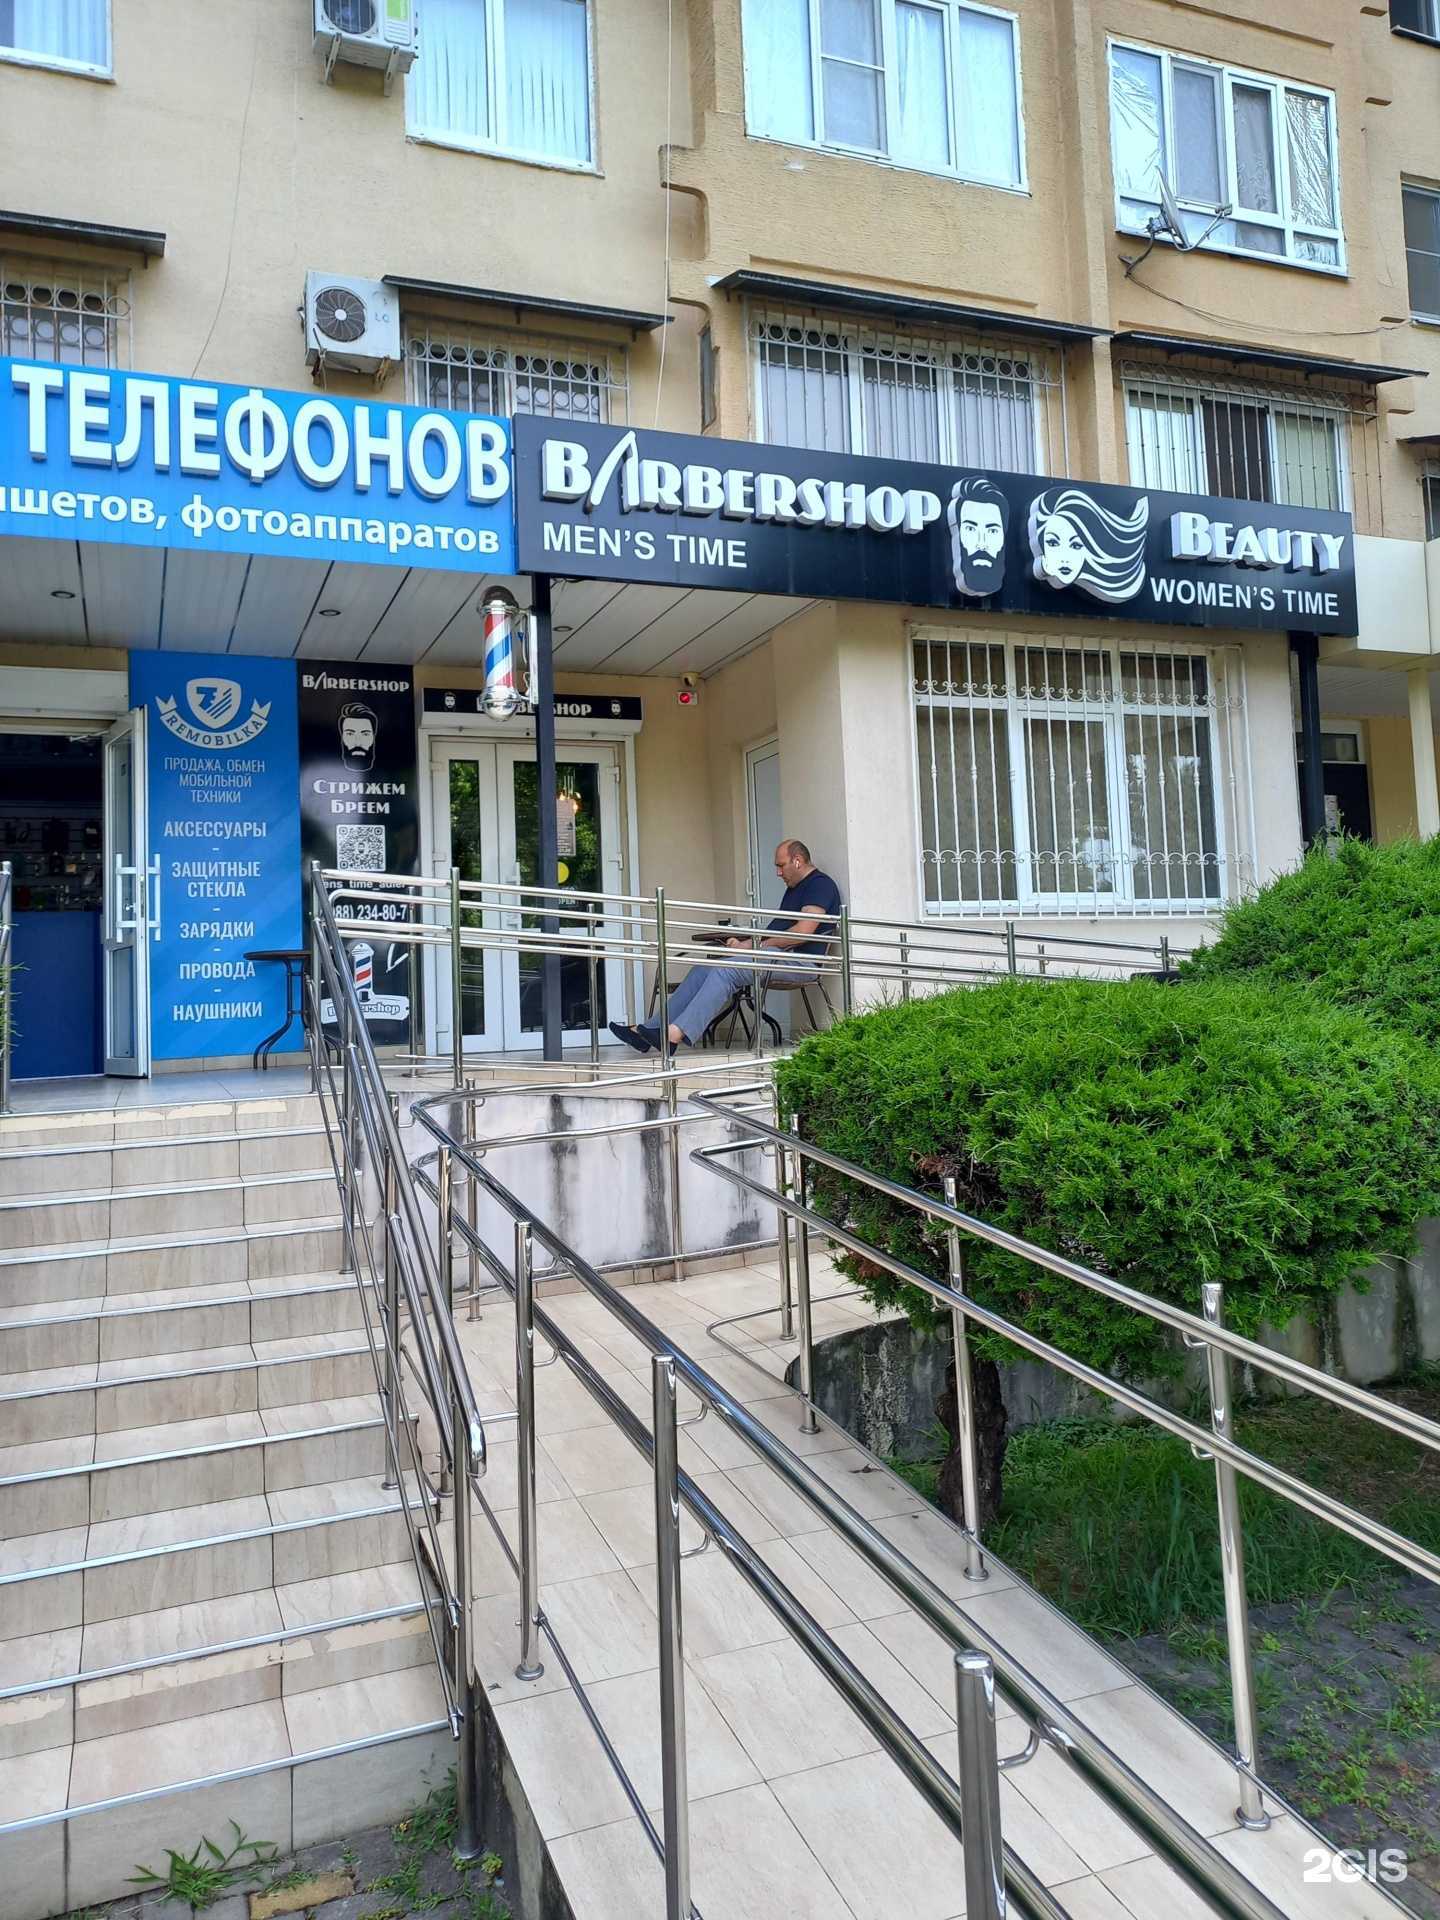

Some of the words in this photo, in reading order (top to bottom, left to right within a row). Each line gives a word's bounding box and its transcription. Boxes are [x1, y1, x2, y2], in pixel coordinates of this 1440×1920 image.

[11, 364, 510, 505] ТЕЛЕФОНОВ
[541, 430, 942, 534] BARBERSHOP
[0, 486, 169, 530] шетов,
[181, 494, 501, 553] фотоаппаратов
[543, 522, 656, 561] MEN'S
[666, 534, 749, 569] TIME
[1170, 511, 1346, 574] BEAUTY
[1150, 577, 1275, 611] WOMEN'S
[1283, 589, 1340, 617] TIME
[302, 671, 410, 692] BARBERSHOP
[165, 714, 264, 746] REMOBILKA
[226, 760, 265, 773] ОБМЕН
[179, 773, 252, 788] МОБИЛЬНОЙ
[313, 779, 406, 796] СТРИЖЕМ
[191, 789, 241, 804] ТЕХНИКИ
[331, 799, 390, 815] БРЕЕМ
[164, 821, 267, 839] АКСЕССУАРЫ
[171, 861, 261, 879] ЗАЩИТНЫЕ
[187, 881, 246, 898] СТЕКЛА
[357, 904, 408, 921] 234-80-7
[180, 922, 254, 940] ЗАРЯДКИ
[180, 961, 256, 980] ПРОВОДА
[173, 1002, 263, 1022] НАУШНИКИ
